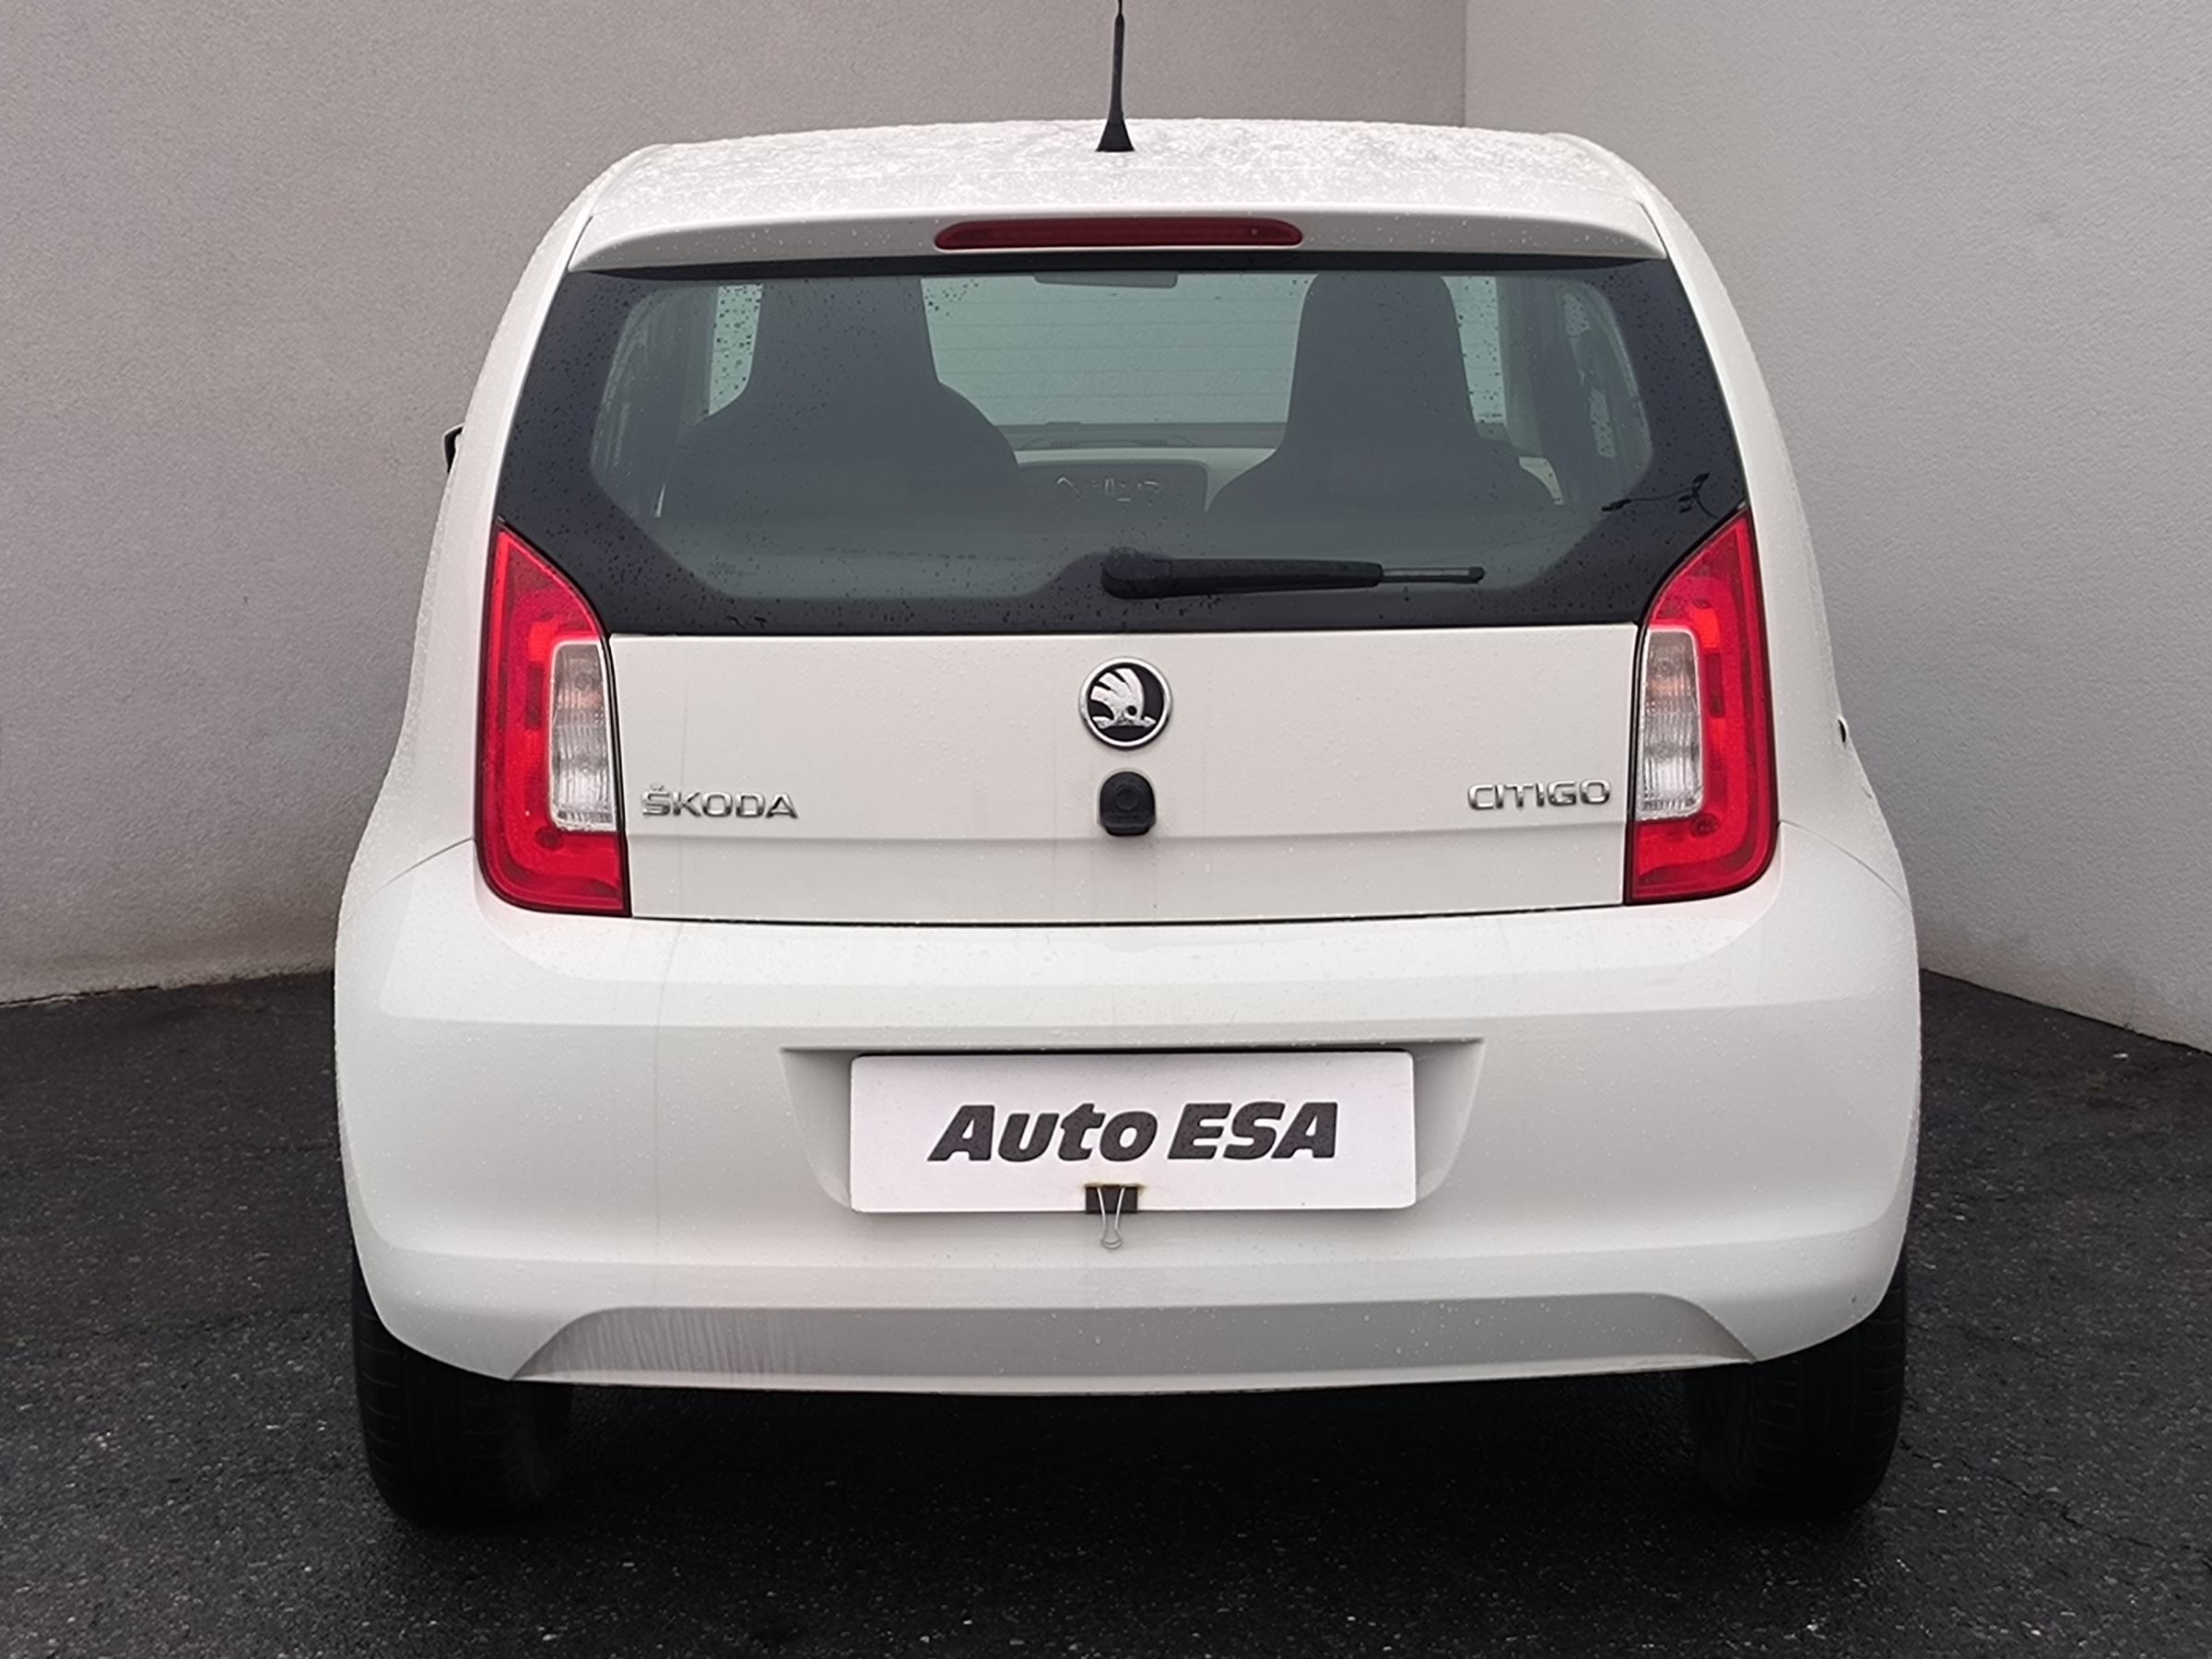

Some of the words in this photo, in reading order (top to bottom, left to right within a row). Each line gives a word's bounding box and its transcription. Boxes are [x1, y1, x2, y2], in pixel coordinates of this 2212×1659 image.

[642, 784, 798, 818] ŠKODA
[1467, 779, 1610, 810] CITIGO
[926, 1102, 1158, 1161] Auto
[1167, 1101, 1338, 1159] ESA
